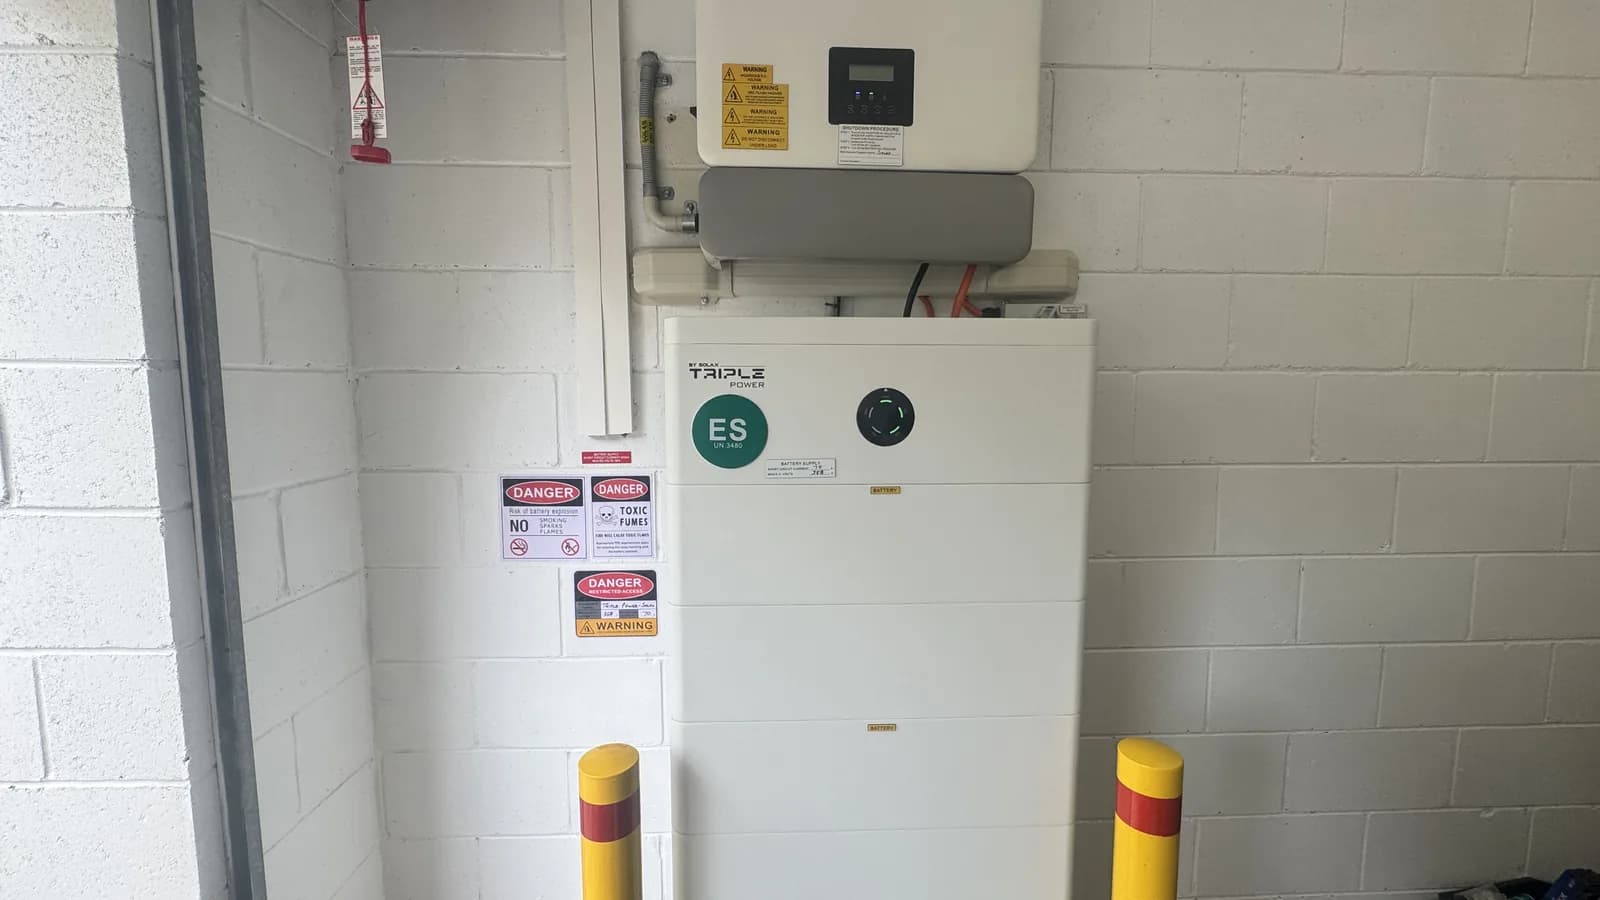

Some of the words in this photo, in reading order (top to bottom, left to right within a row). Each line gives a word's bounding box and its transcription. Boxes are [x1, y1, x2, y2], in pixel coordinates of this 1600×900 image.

[689, 368, 765, 379] TRIPLE
[709, 418, 747, 442] ES
[513, 487, 574, 498] DANGER
[599, 484, 644, 494] DANGER
[529, 507, 550, 516] battery
[551, 507, 579, 516] explosion
[620, 506, 648, 515] TOXIC
[510, 519, 529, 532] NO
[620, 518, 648, 526] FUMES
[588, 578, 642, 588] DANGER
[596, 621, 653, 630] WARNING
